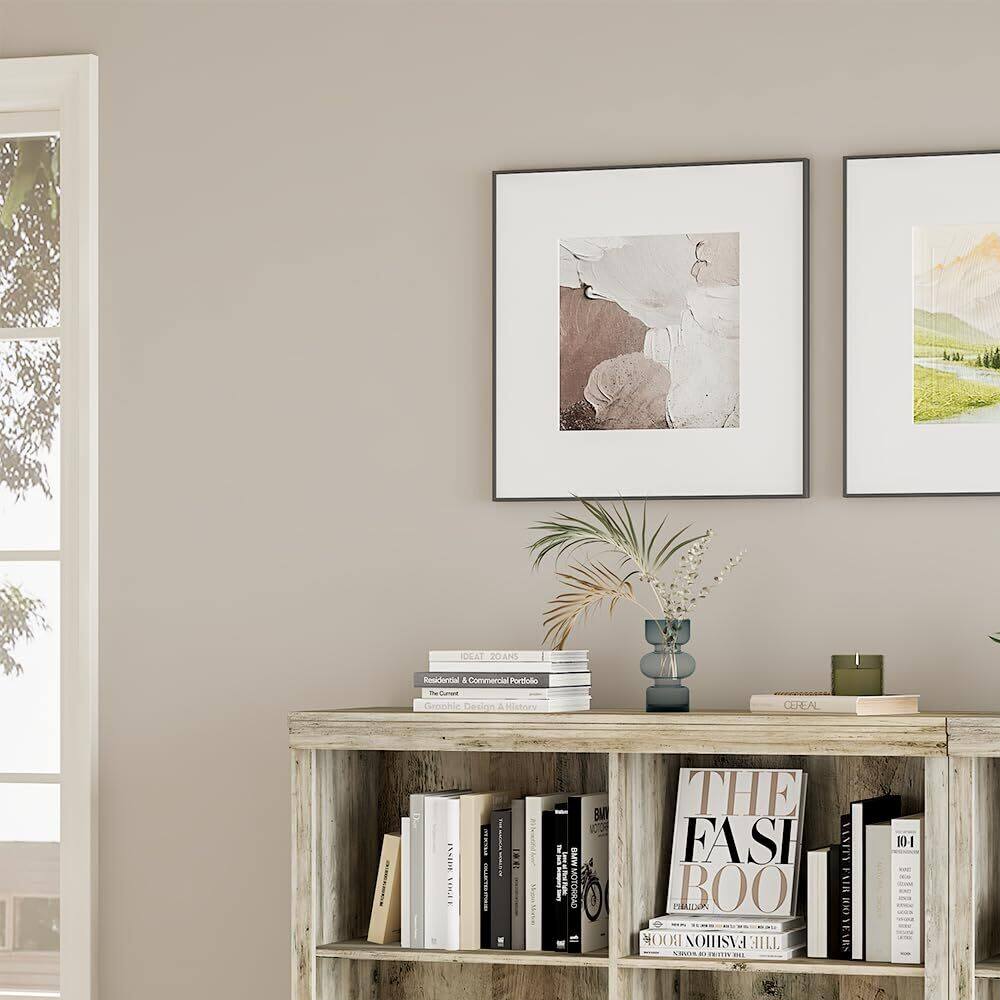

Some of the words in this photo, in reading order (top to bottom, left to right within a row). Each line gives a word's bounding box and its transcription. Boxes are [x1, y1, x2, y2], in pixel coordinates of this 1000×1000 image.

[424, 676, 460, 684] Residential
[510, 676, 538, 685] Portfolio
[424, 703, 461, 712] Graphic
[464, 702, 495, 712] Design
[505, 703, 537, 712] History
[784, 701, 820, 710] CEREAL
[688, 770, 798, 817] THE
[841, 822, 851, 862] VANITY
[570, 847, 578, 867] BMW
[570, 868, 578, 909] MOTORRAD
[841, 867, 851, 893] FAIR
[673, 903, 710, 912] PHAIDON
[686, 933, 746, 949] FASHION
[747, 934, 780, 950] THE
[841, 918, 851, 952] YEARS
